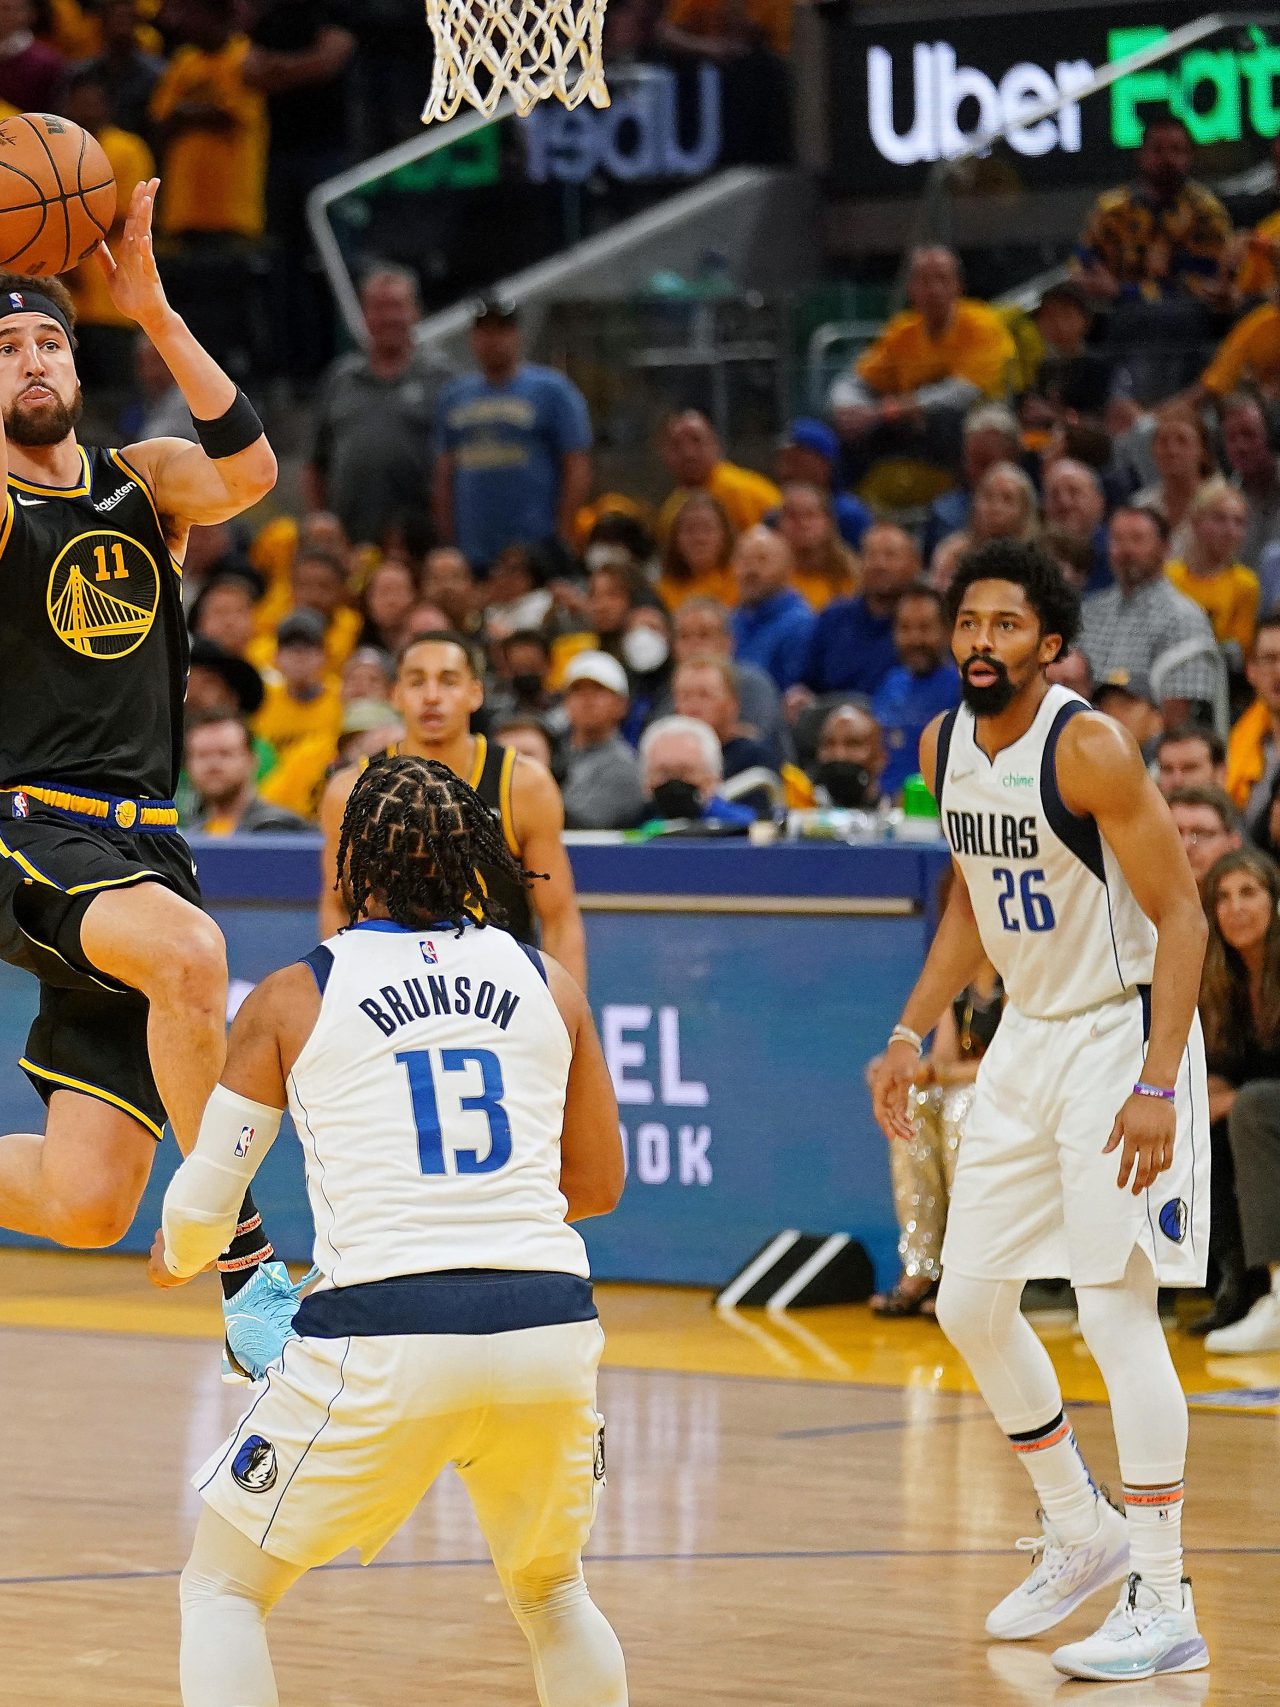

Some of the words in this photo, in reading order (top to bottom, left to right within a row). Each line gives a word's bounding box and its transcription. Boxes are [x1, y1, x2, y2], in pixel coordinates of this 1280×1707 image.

[867, 40, 1097, 166] Uber
[93, 481, 137, 512] Rakuten
[93, 543, 130, 581] 11
[1002, 771, 1035, 788] chime
[946, 809, 1040, 859] DALLAS
[992, 867, 1056, 932] 26
[358, 975, 521, 1038] BRUNSON
[393, 1047, 513, 1176] 13
